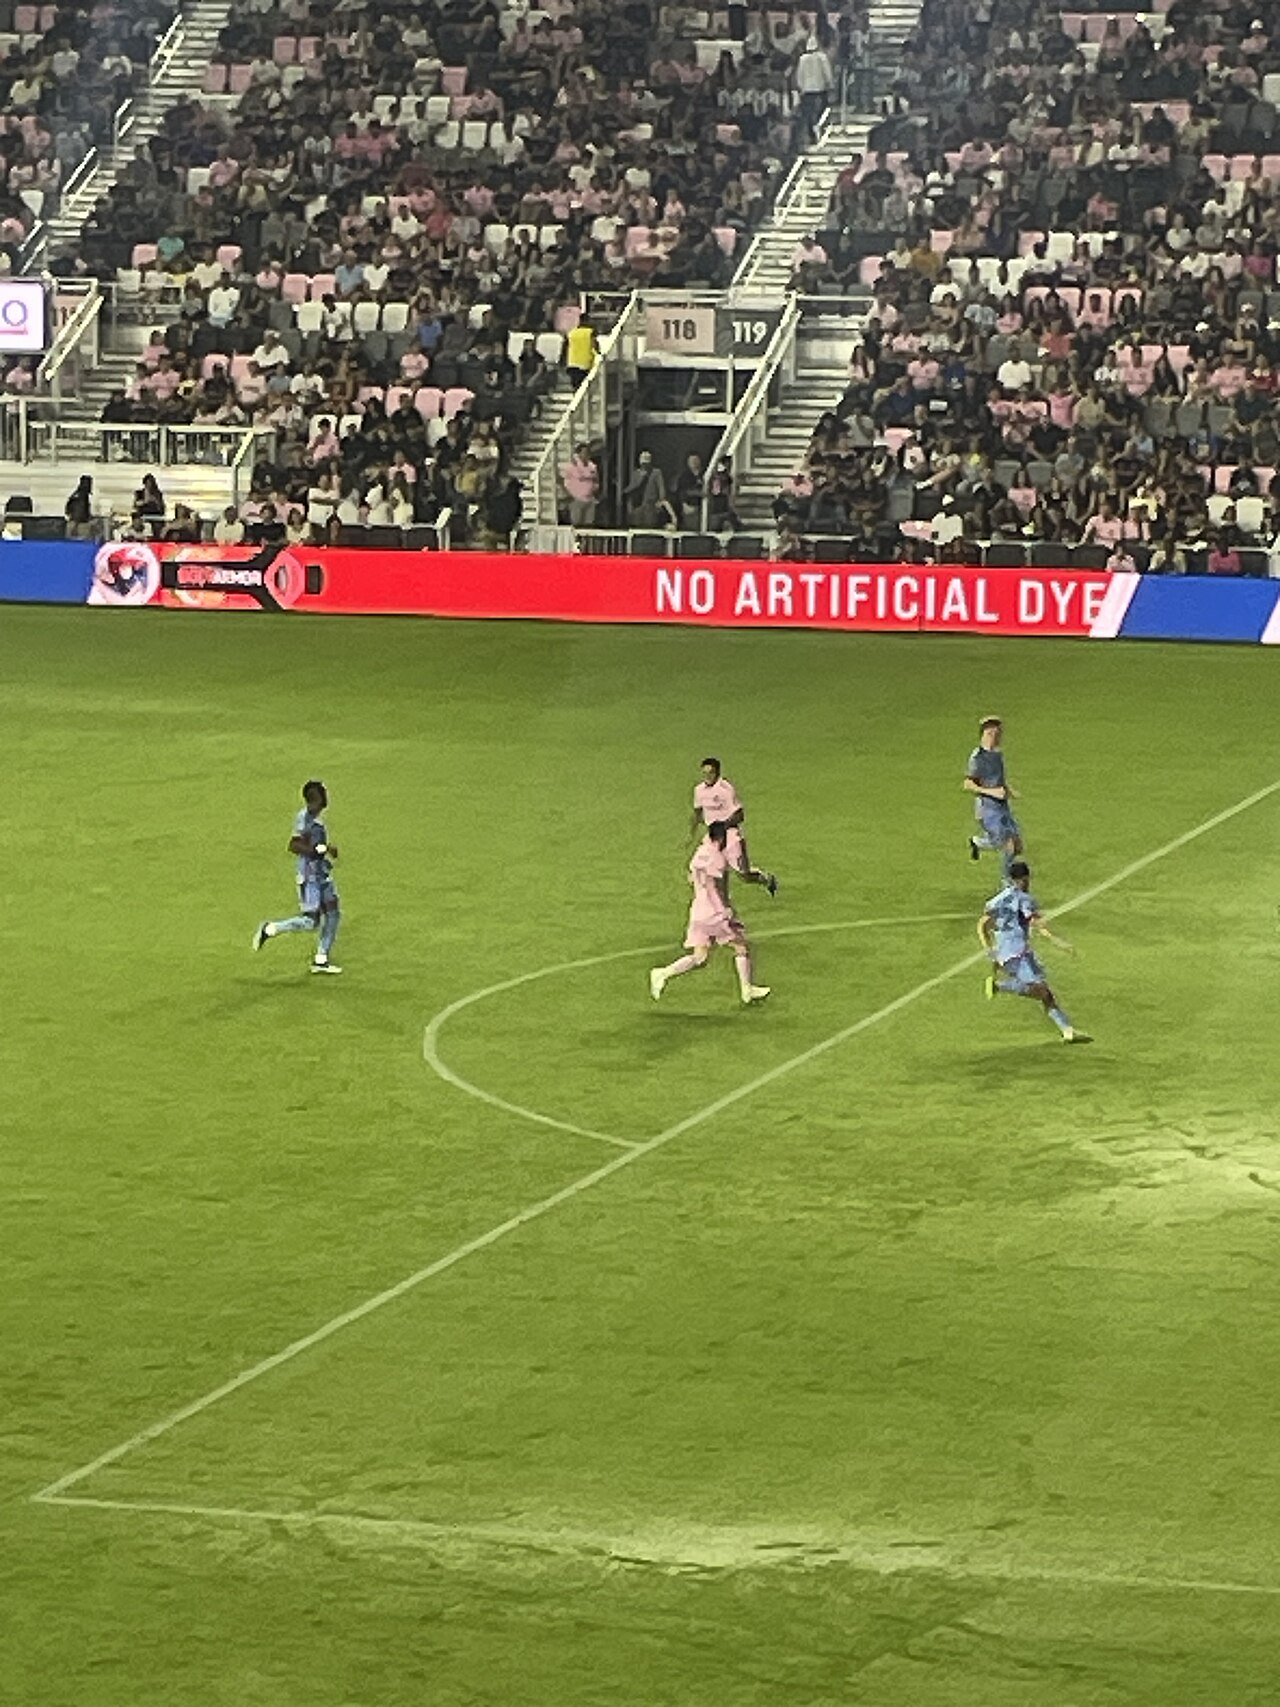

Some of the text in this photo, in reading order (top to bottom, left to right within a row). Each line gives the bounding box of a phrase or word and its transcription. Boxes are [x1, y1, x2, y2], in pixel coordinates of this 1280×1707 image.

[663, 319, 697, 340] 118
[732, 321, 768, 344] 119
[656, 568, 716, 615] NO
[734, 570, 1000, 622] ARTIFICIAL
